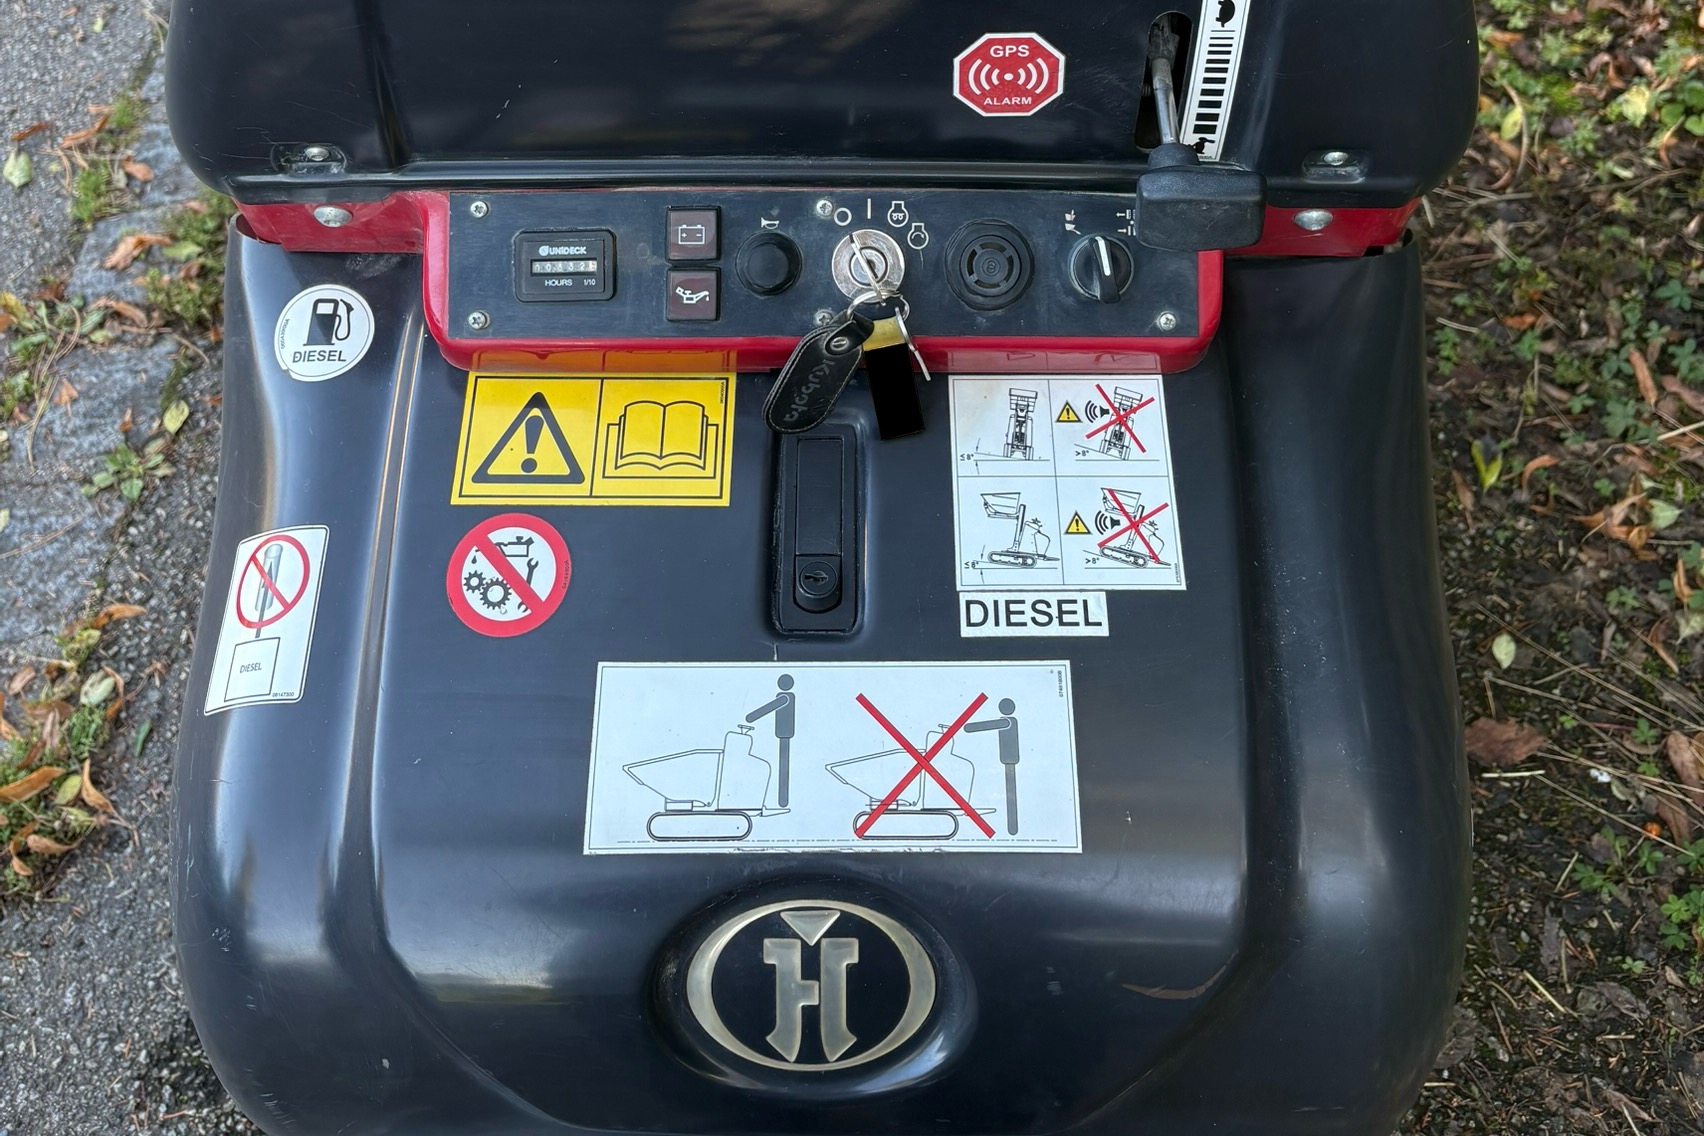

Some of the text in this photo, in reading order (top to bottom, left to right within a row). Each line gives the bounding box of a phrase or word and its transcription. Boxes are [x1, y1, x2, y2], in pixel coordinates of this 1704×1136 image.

[990, 45, 1030, 58] GPS
[983, 96, 1033, 106] ALARM
[549, 246, 587, 255] UNIDECK
[292, 349, 347, 363] DIESEL
[784, 359, 835, 421] Kubota
[965, 599, 1102, 627] DIESEL
[239, 662, 262, 674] DIESEL
